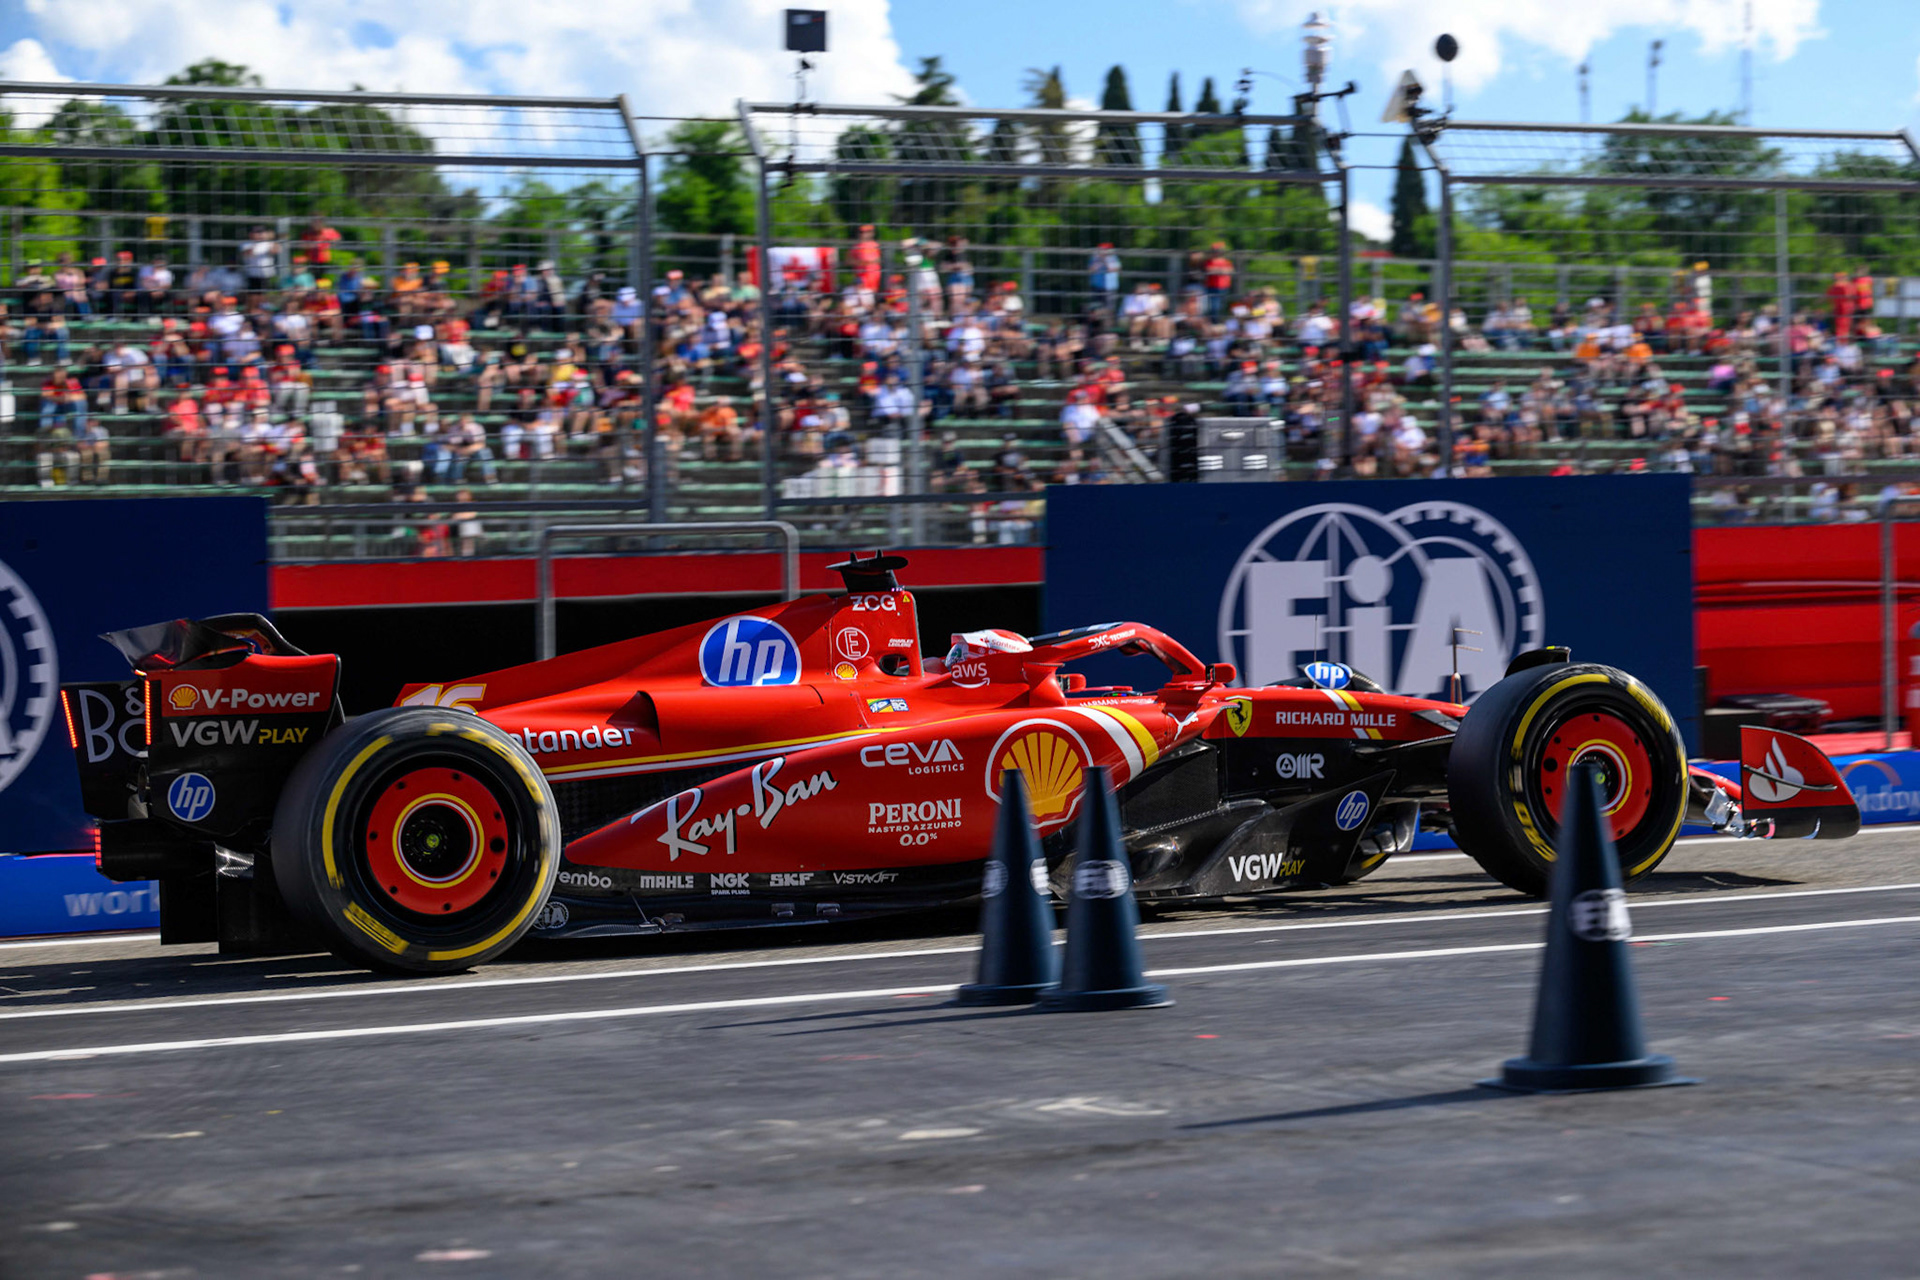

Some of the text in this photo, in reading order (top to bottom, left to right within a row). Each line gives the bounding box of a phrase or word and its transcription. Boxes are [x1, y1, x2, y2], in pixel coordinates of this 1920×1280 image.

[850, 595, 896, 611] ZCG
[717, 618, 787, 687] hp
[952, 662, 988, 679] aws
[1314, 661, 1345, 689] hp
[201, 688, 320, 709] V-Power
[1276, 711, 1396, 727] RICHARD MILLE
[169, 720, 309, 748] VGW PLAY
[908, 763, 964, 775] LOGISTICS
[174, 774, 211, 821] hp
[868, 798, 962, 825] PERONI
[1339, 790, 1368, 830] hp
[868, 820, 962, 834] NASTRO AZZURRO
[899, 832, 938, 846] 0.0%
[1228, 852, 1305, 882] VGW PLAY
[556, 871, 612, 888] embo
[640, 875, 694, 889] MAHLE
[710, 872, 750, 888] NGK
[769, 872, 814, 887] SKF
